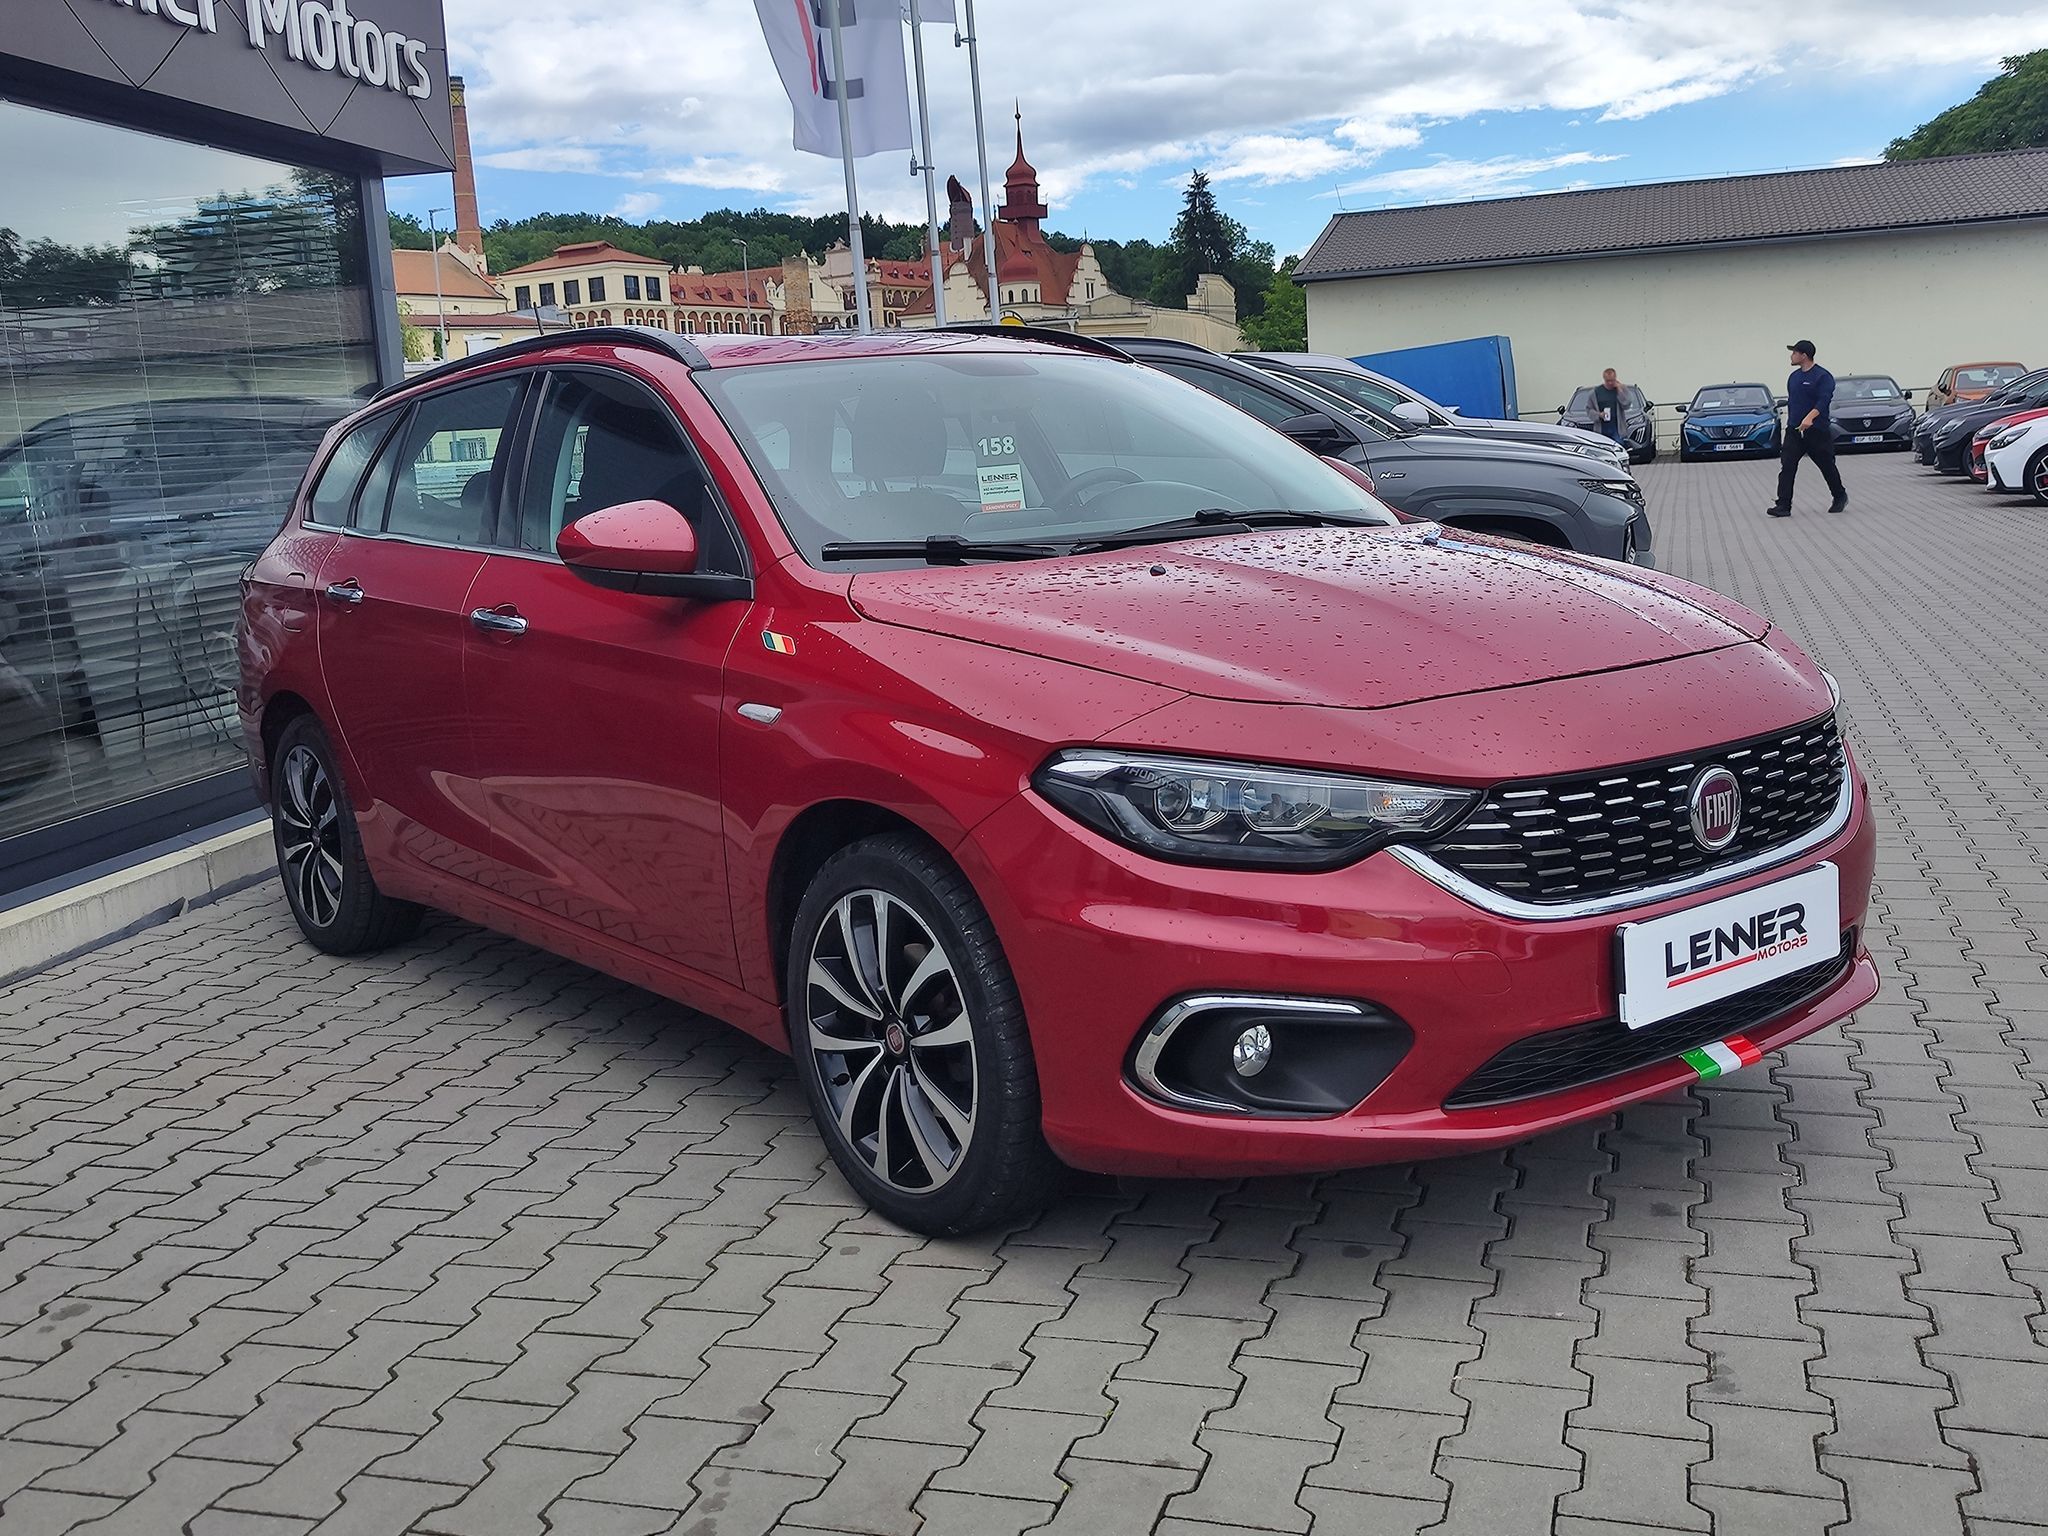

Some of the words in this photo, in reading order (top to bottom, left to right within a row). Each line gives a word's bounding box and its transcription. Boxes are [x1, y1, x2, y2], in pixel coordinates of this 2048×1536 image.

[977, 436, 1015, 456] 158
[1705, 790, 1732, 829] FIAT
[1665, 902, 1807, 978] LENNER
[1757, 934, 1808, 961] MOTORS
